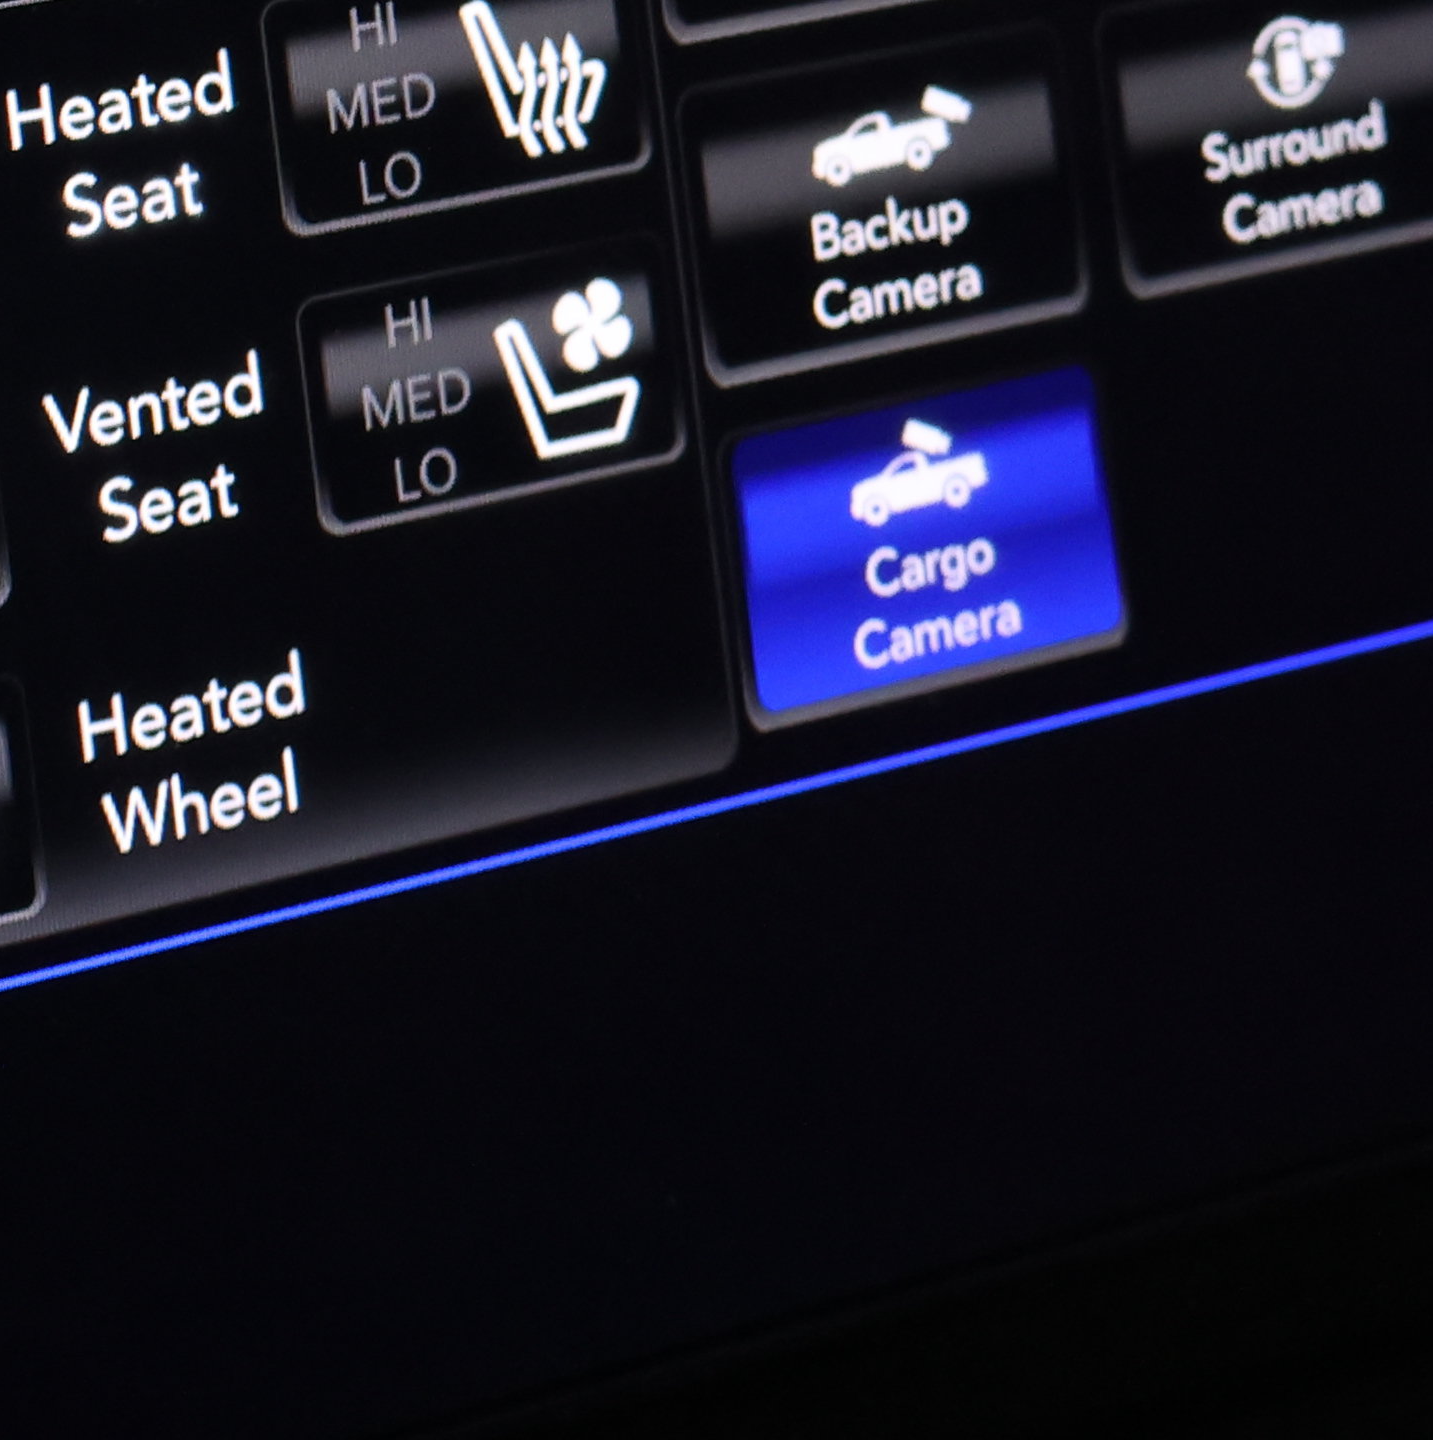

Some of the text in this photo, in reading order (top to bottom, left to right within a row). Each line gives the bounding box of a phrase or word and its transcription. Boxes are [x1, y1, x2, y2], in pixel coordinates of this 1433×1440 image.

[349, 1, 397, 52] HI
[6, 47, 234, 151] Heated
[326, 72, 435, 133] MED
[1201, 98, 1386, 182] Surround
[63, 163, 203, 238] Seat
[358, 151, 422, 205] LO
[1222, 178, 1384, 244] Camera
[811, 197, 969, 262] Backup
[385, 297, 433, 348] HI
[813, 263, 983, 329] Camera
[43, 348, 264, 453] Vented
[361, 367, 472, 431] MED
[99, 465, 240, 543] Seat
[394, 447, 457, 503] LO
[865, 537, 995, 597] Cargo
[854, 599, 1022, 669] Camera
[78, 648, 307, 764] Heated
[102, 747, 300, 854] Wheel
